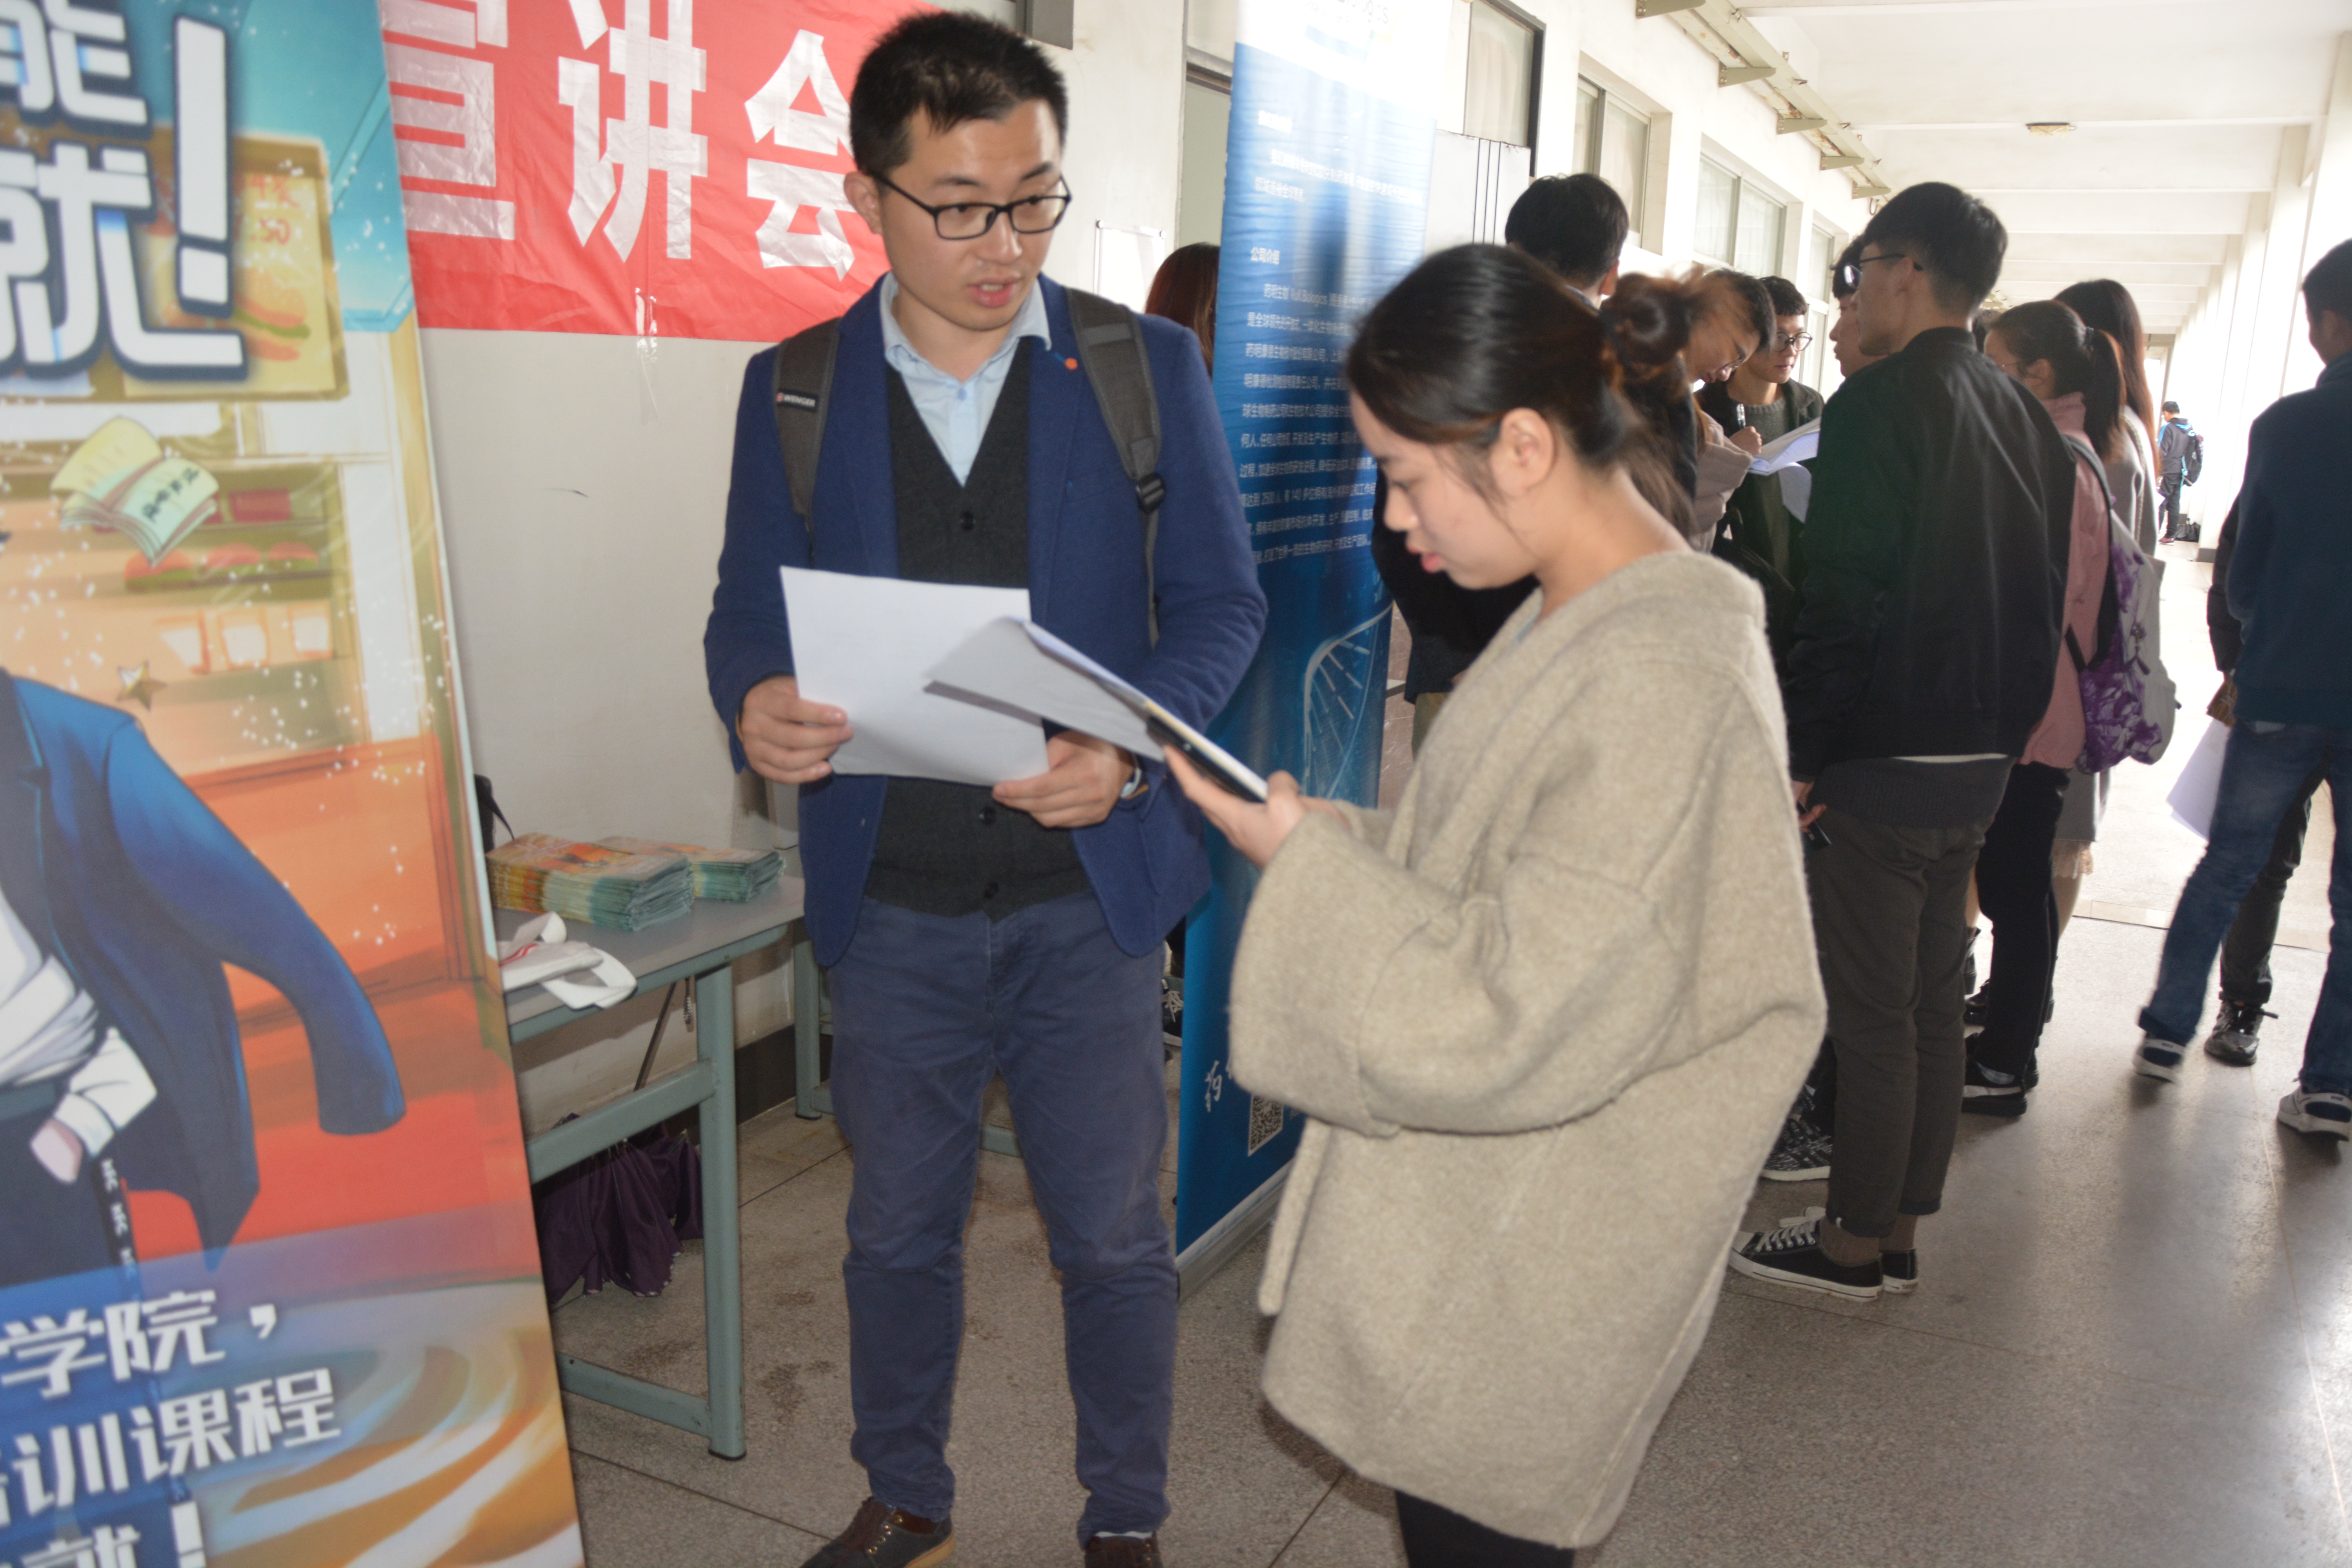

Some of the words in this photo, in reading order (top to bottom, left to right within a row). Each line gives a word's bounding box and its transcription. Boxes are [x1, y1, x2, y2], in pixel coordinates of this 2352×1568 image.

[784, 394, 815, 407] WENGER
[0, 1368, 341, 1526] 训课程
